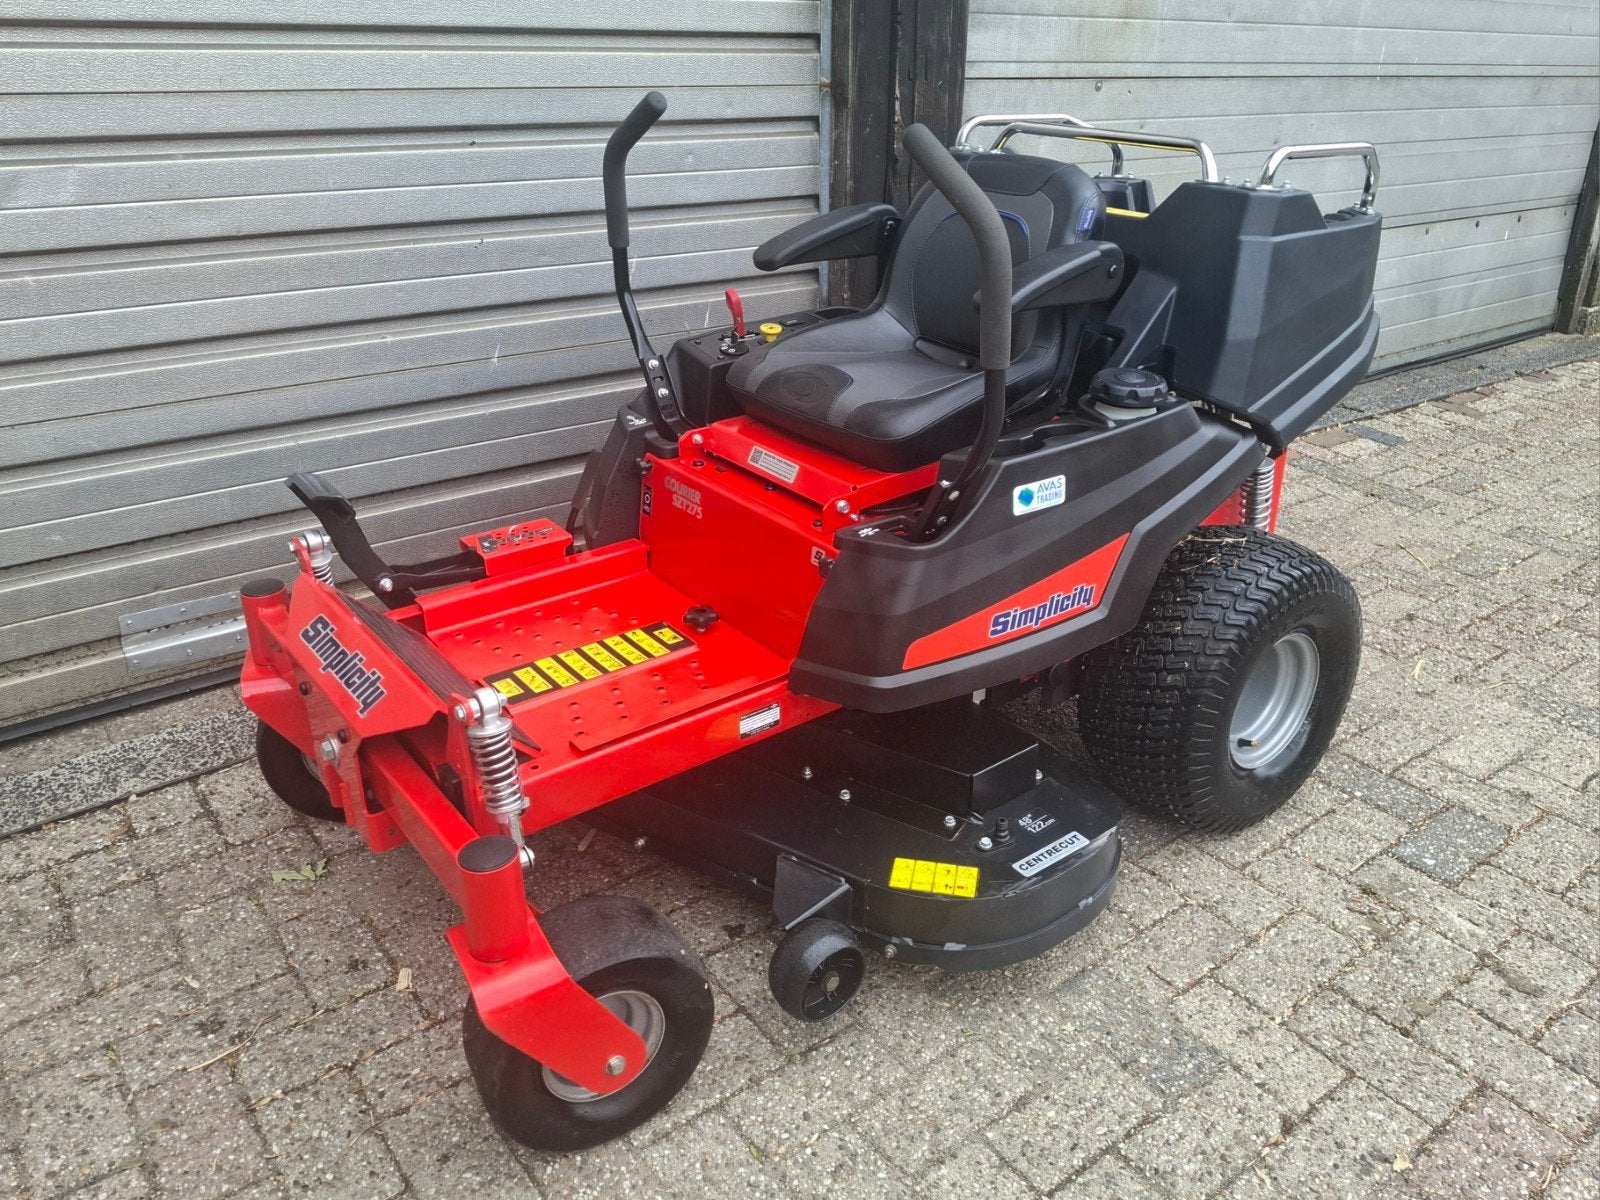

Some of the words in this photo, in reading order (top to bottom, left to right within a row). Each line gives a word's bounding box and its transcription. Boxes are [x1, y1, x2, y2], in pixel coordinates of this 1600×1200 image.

[664, 476, 702, 505] COURIER
[1036, 478, 1063, 495] AVAS
[988, 583, 1096, 638] Simplicity
[300, 613, 387, 718] Simplicity
[1018, 834, 1081, 871] CENTRECUT
